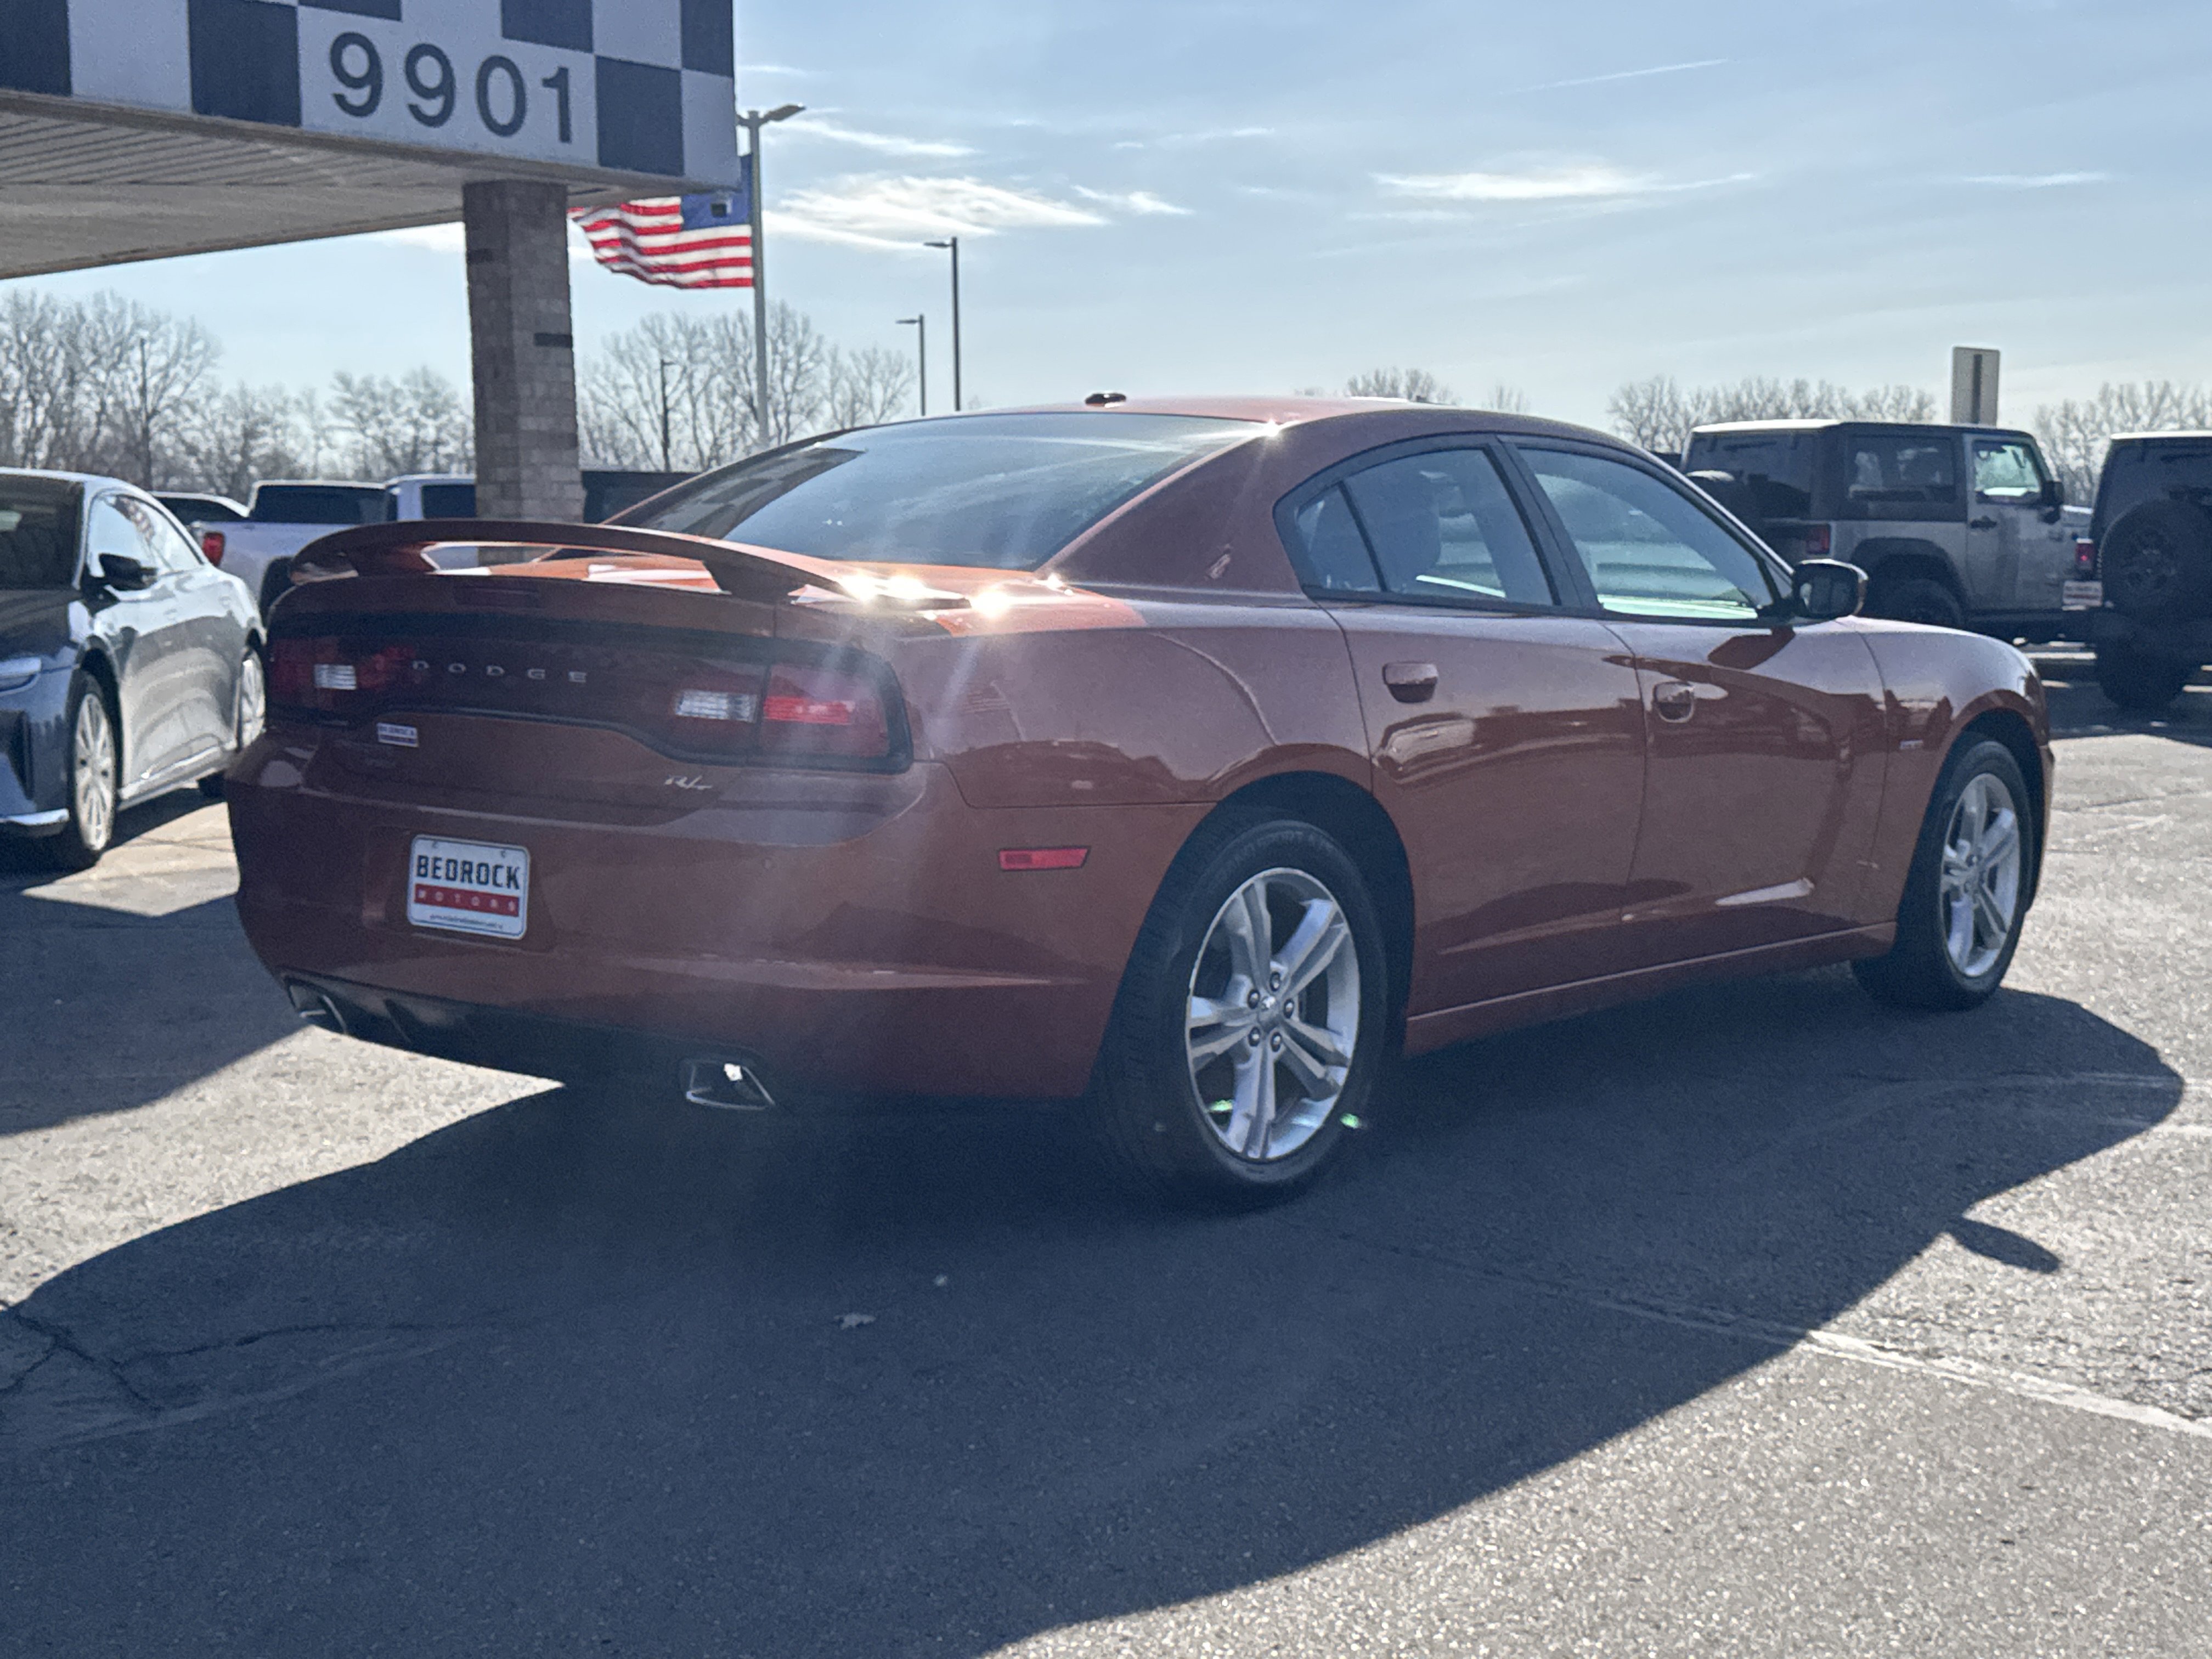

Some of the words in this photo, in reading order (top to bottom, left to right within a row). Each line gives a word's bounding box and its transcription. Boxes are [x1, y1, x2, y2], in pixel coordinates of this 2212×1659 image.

[330, 31, 572, 144] 9901
[412, 660, 587, 684] DODGE
[416, 854, 521, 890] BEDROCK
